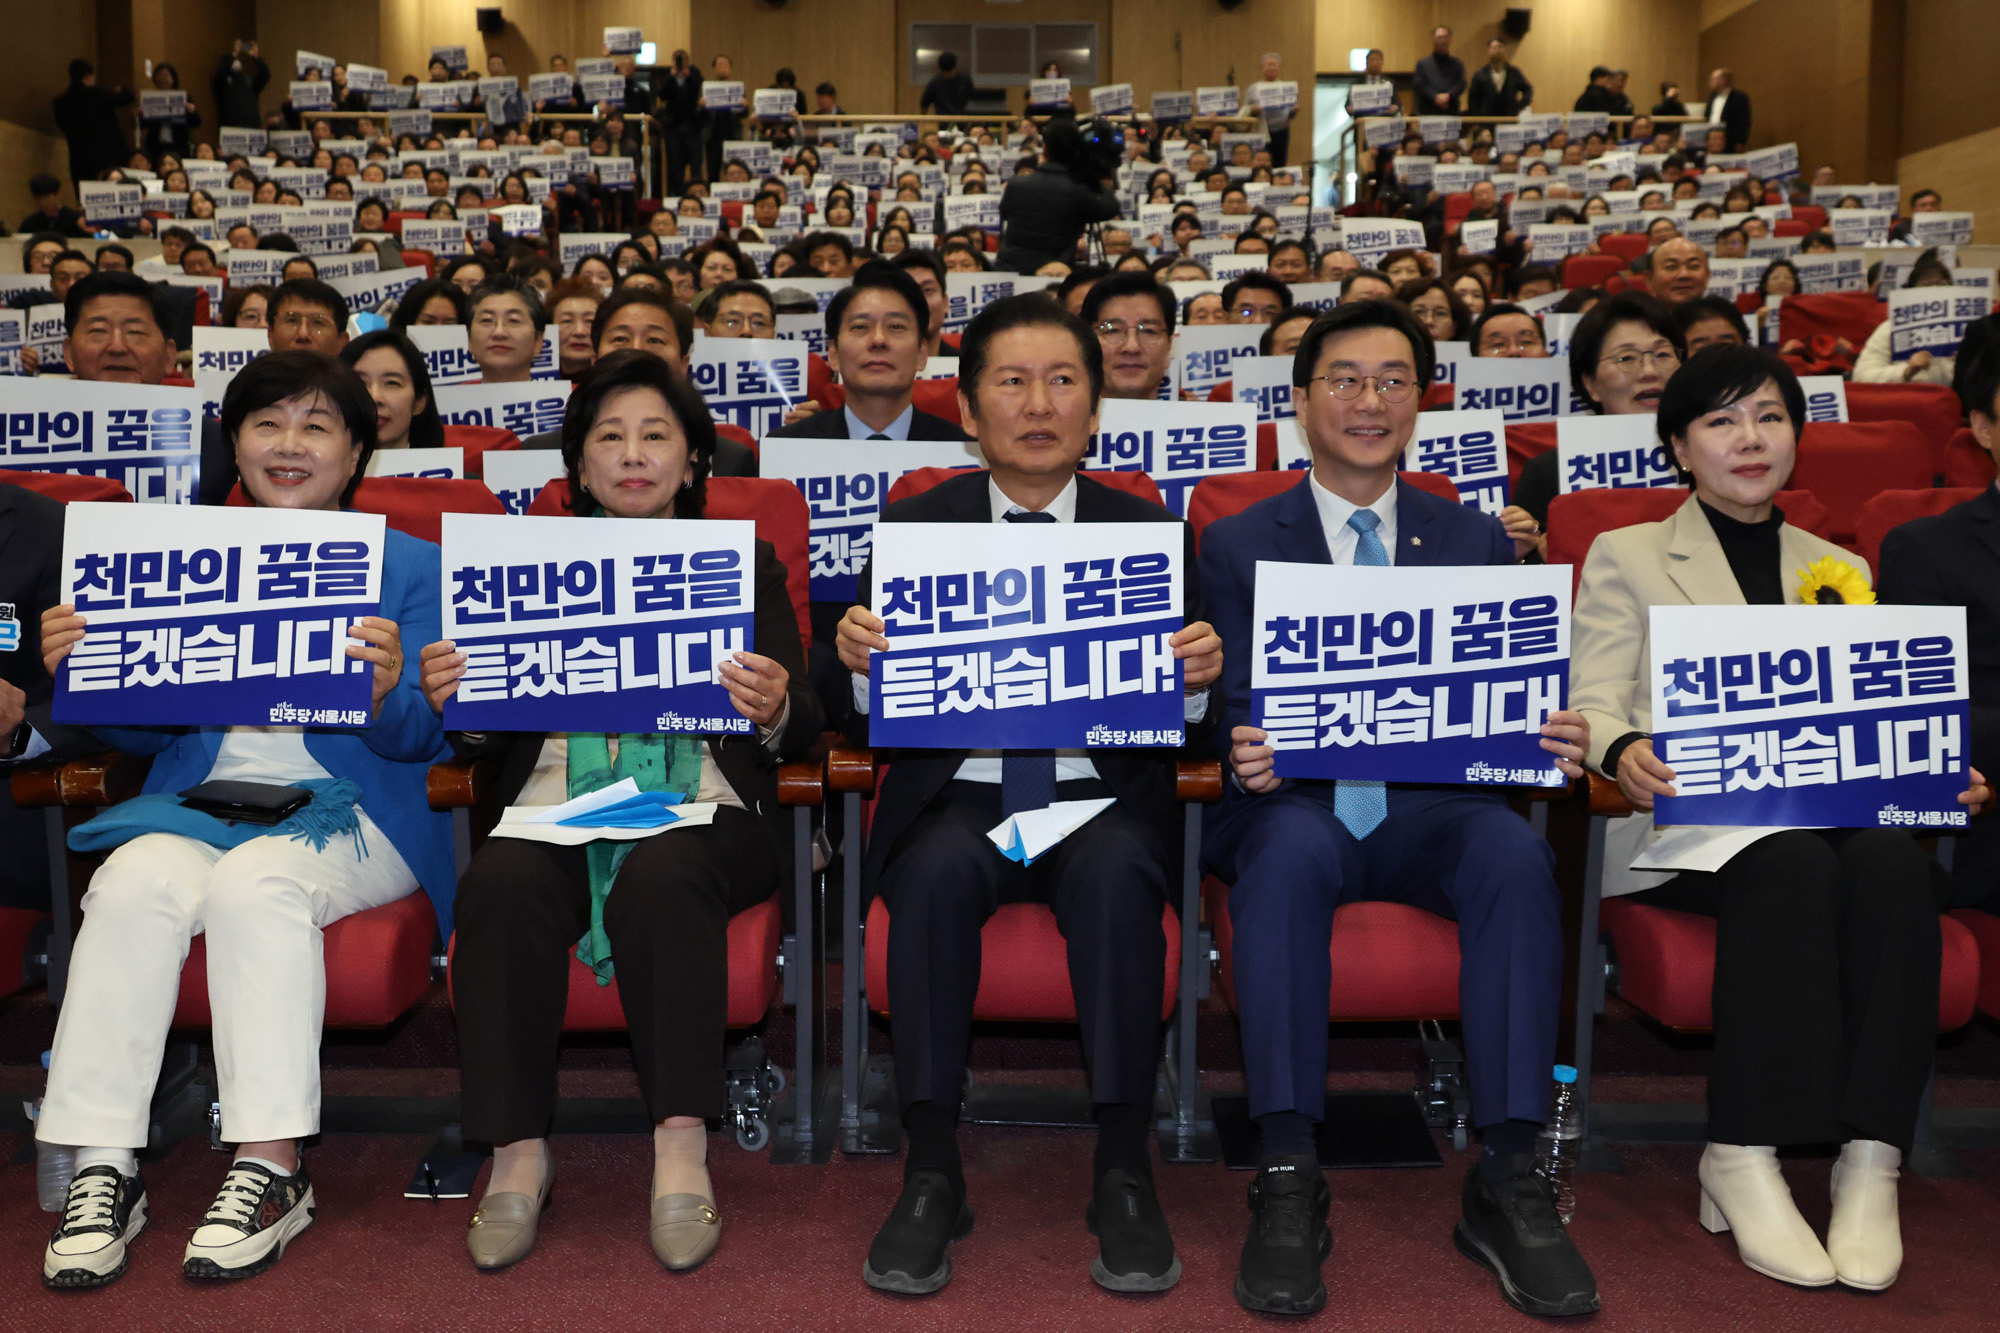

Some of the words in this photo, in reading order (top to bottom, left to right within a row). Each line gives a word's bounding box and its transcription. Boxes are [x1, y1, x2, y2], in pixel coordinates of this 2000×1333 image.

[736, 357, 800, 395] 꿈을
[107, 408, 192, 452] 꿈을
[1166, 424, 1247, 471] 꿈을
[1418, 431, 1498, 477] 꿈을
[797, 472, 889, 520] 만의
[72, 546, 241, 612] 천만의
[257, 541, 370, 601] 꿈을
[452, 558, 615, 625] 천만의
[632, 549, 742, 613] 꿈을
[881, 565, 1046, 637] 천만의
[1063, 552, 1172, 621] 꿈을
[1264, 608, 1434, 674] 천만의
[1451, 595, 1559, 663] 꿈을
[881, 632, 1175, 719] 듣겠습니다!
[1662, 646, 1833, 718] 천만의
[1849, 636, 1956, 701] 꿈을
[270, 708, 311, 723] 민주당
[311, 710, 367, 725] 서울시당
[657, 717, 697, 731] 민주당
[697, 718, 751, 732] 서울시당
[1086, 730, 1127, 745] 민주당
[1127, 730, 1182, 745] 서울시당
[1466, 767, 1508, 782] 민주당
[1666, 714, 1961, 797] 듣겠습니다!
[1878, 810, 1917, 825] 민주당
[1917, 811, 1967, 826] 서울시당
